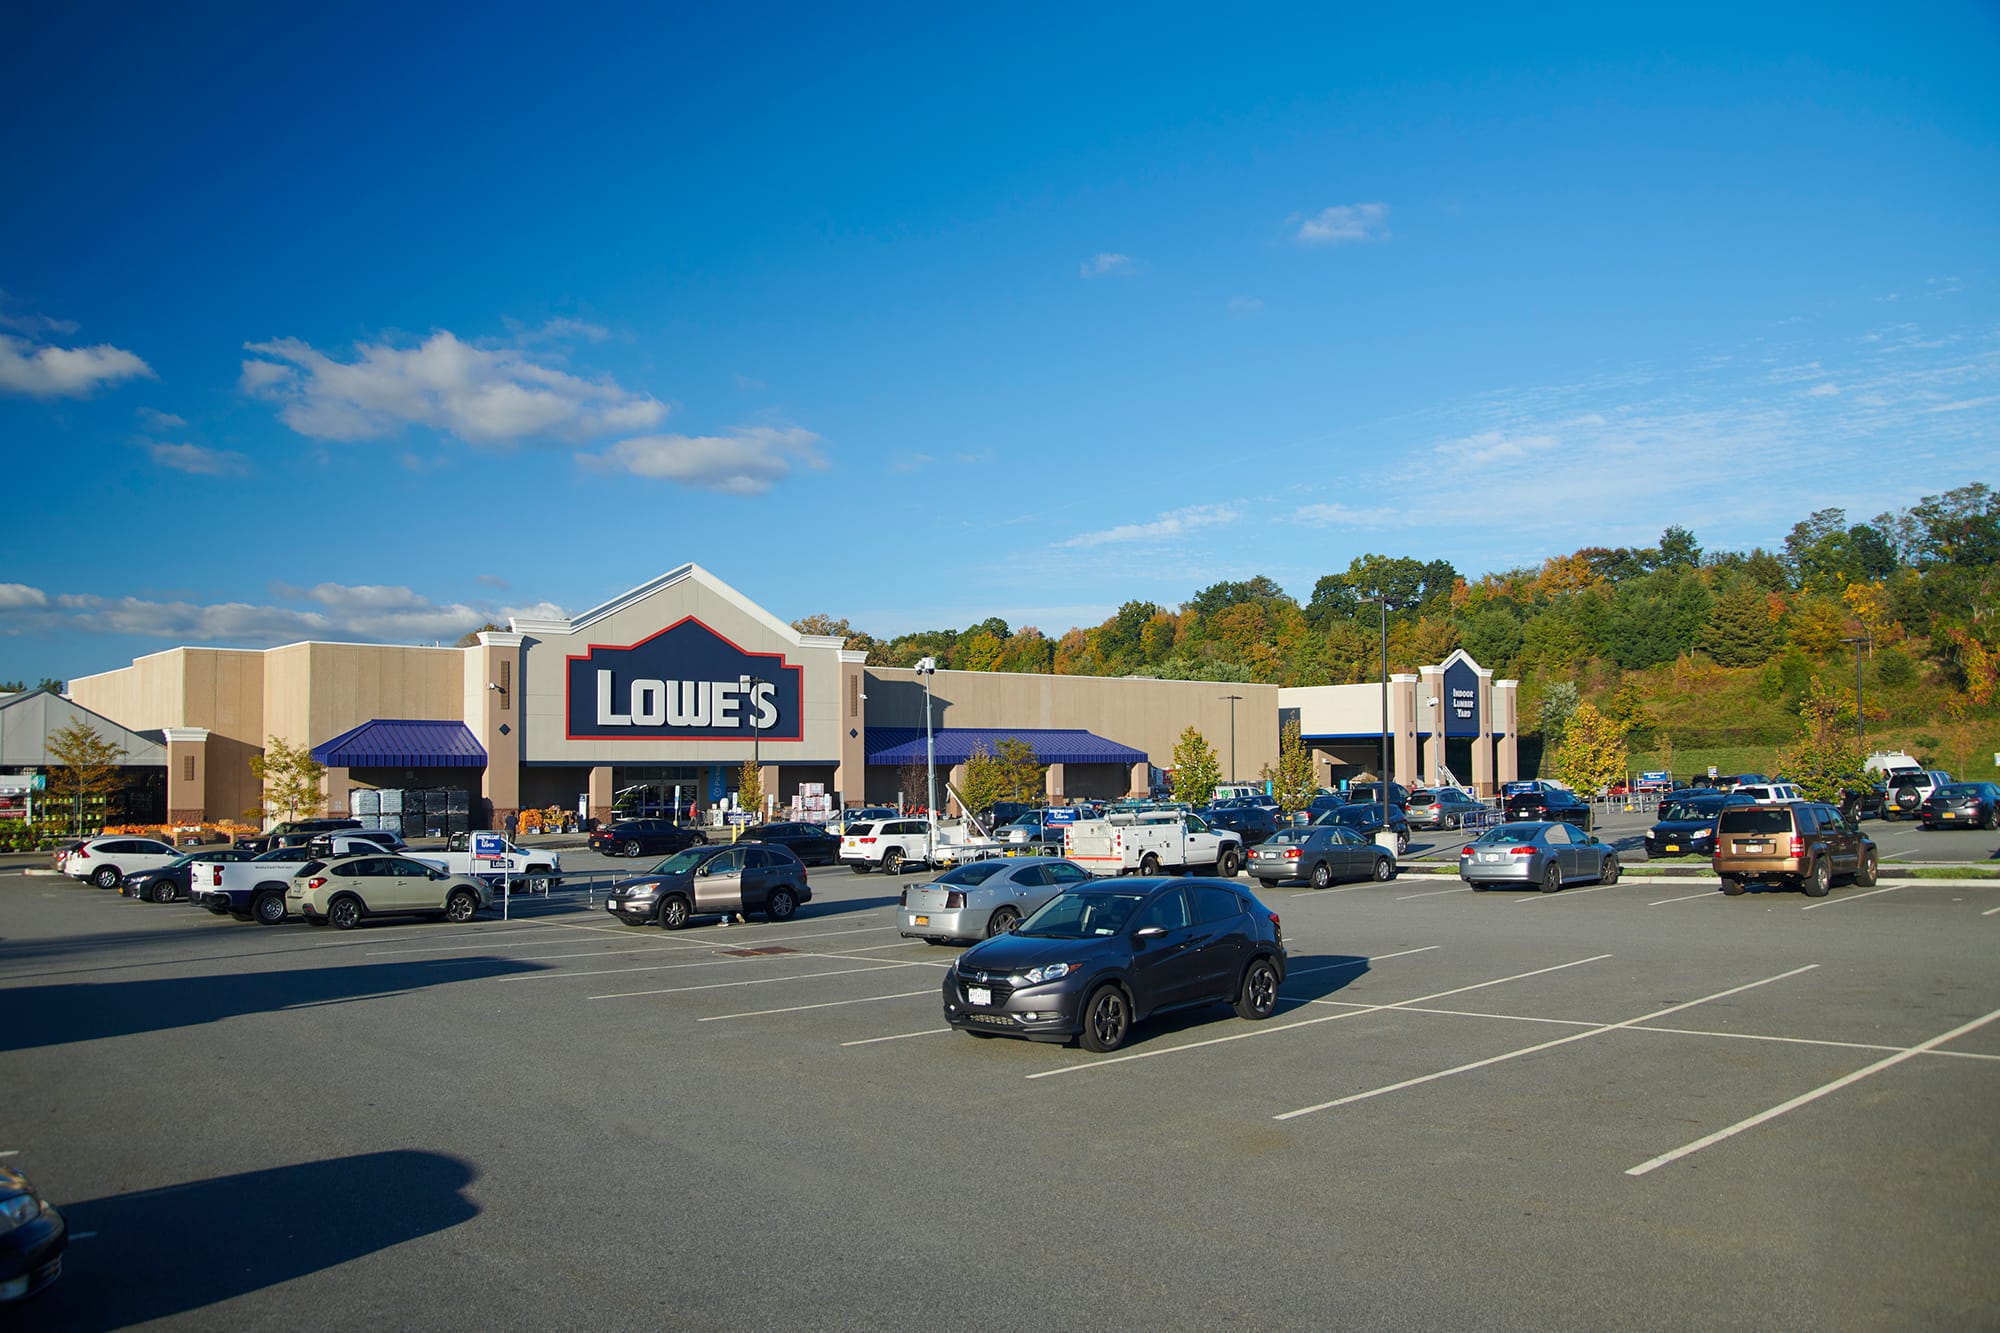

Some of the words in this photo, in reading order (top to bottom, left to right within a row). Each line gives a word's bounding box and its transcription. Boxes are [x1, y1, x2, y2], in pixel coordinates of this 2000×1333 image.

[1453, 687, 1474, 698] INDOOR
[597, 669, 778, 729] LOWE'S
[1453, 698, 1474, 708] LUMBER
[1457, 708, 1471, 717] YARD
